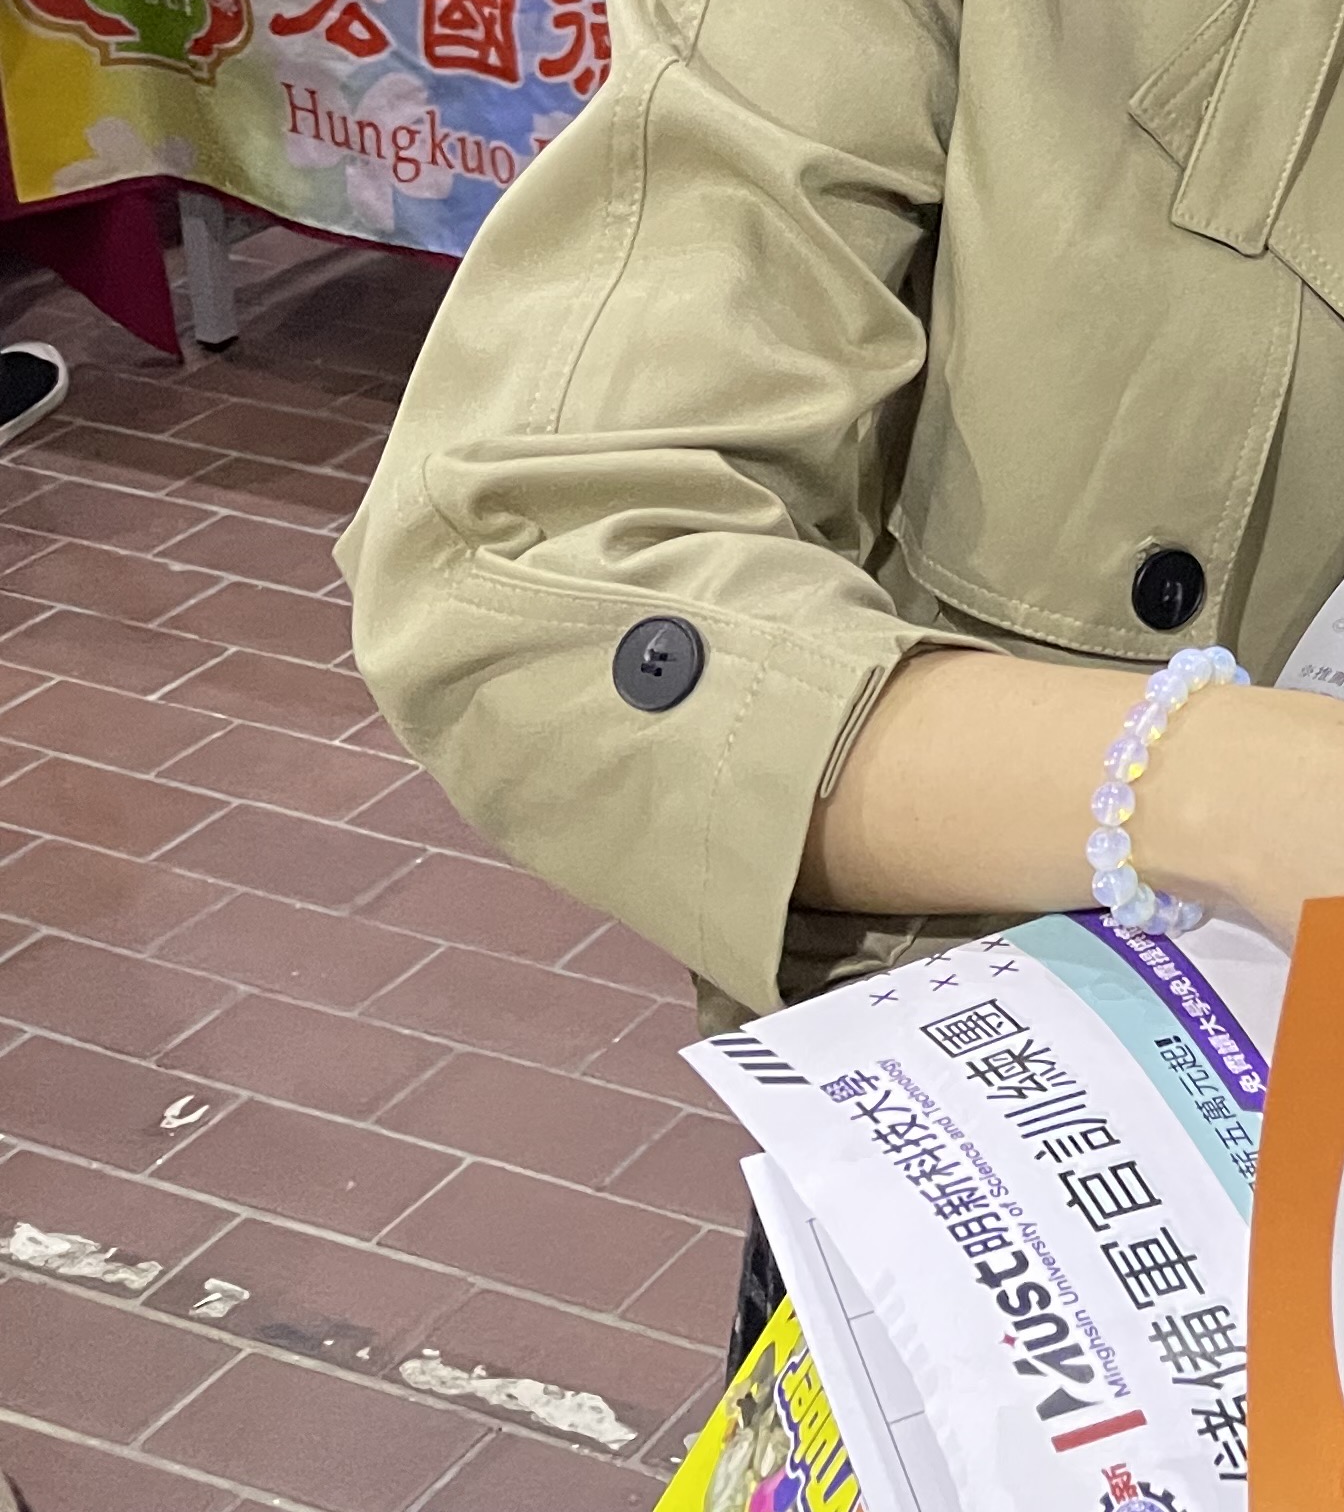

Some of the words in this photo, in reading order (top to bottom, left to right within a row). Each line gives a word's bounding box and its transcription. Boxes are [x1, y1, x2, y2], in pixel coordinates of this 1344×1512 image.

[281, 80, 517, 185] Hungkuo
[875, 1058, 942, 1119] Technology
[932, 1115, 965, 1140] and
[1154, 1035, 1259, 1192] 薪五萬元起!
[820, 1069, 1014, 1259] 明新科技大學
[960, 1141, 1010, 1198] Science
[999, 1201, 1024, 1217] of
[1017, 1221, 1079, 1306] University
[1074, 1308, 1131, 1398] Minghsin
